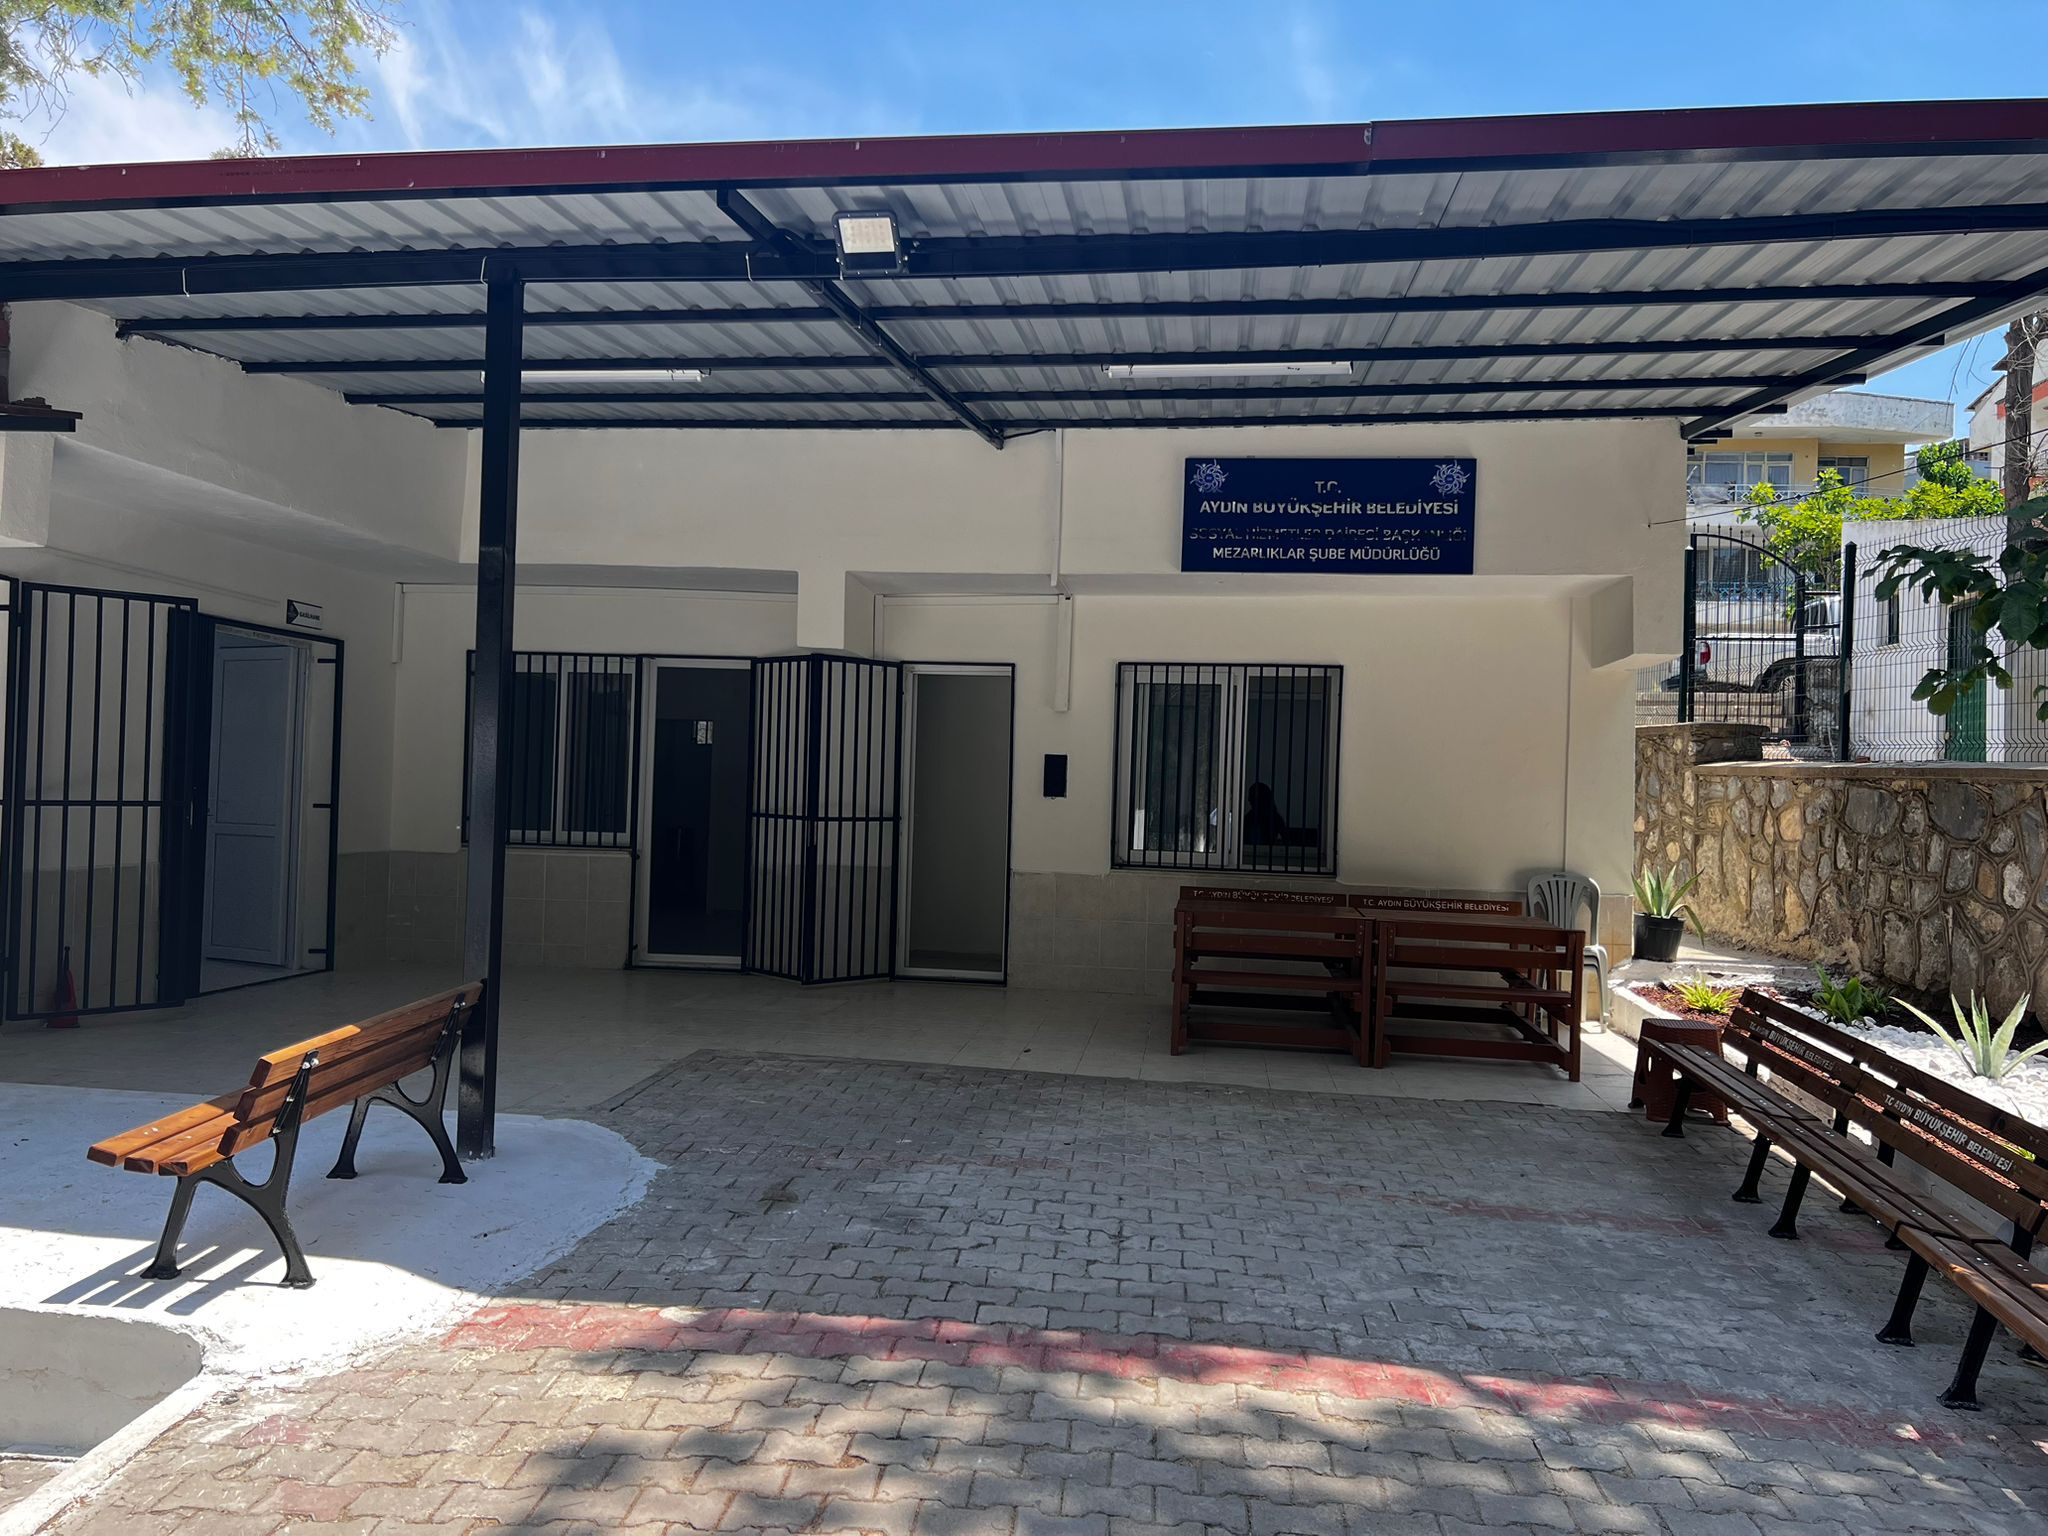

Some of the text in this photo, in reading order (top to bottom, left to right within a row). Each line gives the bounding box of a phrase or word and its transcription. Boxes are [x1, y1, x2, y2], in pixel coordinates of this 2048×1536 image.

[1314, 480, 1342, 494] T.C.
[1199, 500, 1248, 514] AYDIN
[1366, 498, 1459, 515] BELEDİYESİ
[1383, 526, 1467, 545] BAŞKIĞI
[1212, 545, 1441, 562] MEZARLIKLAR ŞUBE MÜDÜRLÜĞÜ
[1378, 899, 1402, 908] AYDIN
[1403, 898, 1463, 911] BÜYÜKŞEHİR
[1464, 902, 1510, 912] BELEDİYESİ
[1913, 1108, 1969, 1147] BÜYÜKŞEHİR
[1966, 1140, 2014, 1173] BELEDİYESİ
